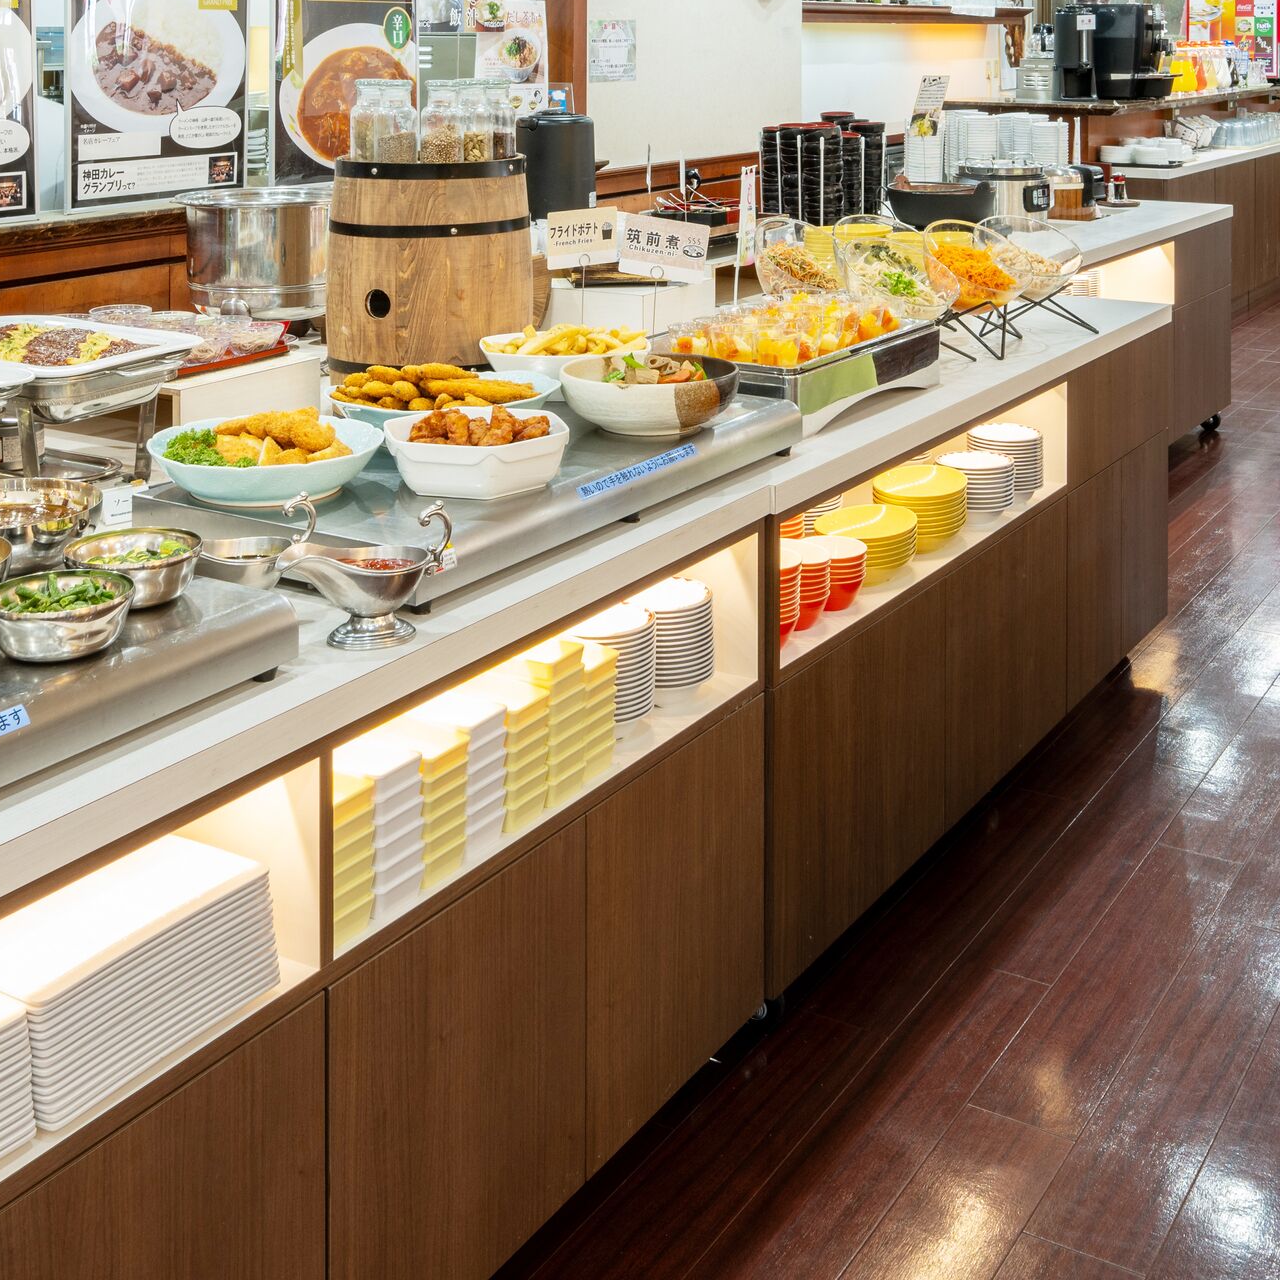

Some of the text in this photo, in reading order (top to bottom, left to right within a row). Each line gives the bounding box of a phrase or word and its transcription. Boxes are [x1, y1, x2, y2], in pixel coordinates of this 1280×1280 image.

[82, 168, 125, 182] 神田カレー
[550, 221, 599, 239] フライドポテト
[626, 227, 681, 250] 筑前煮
